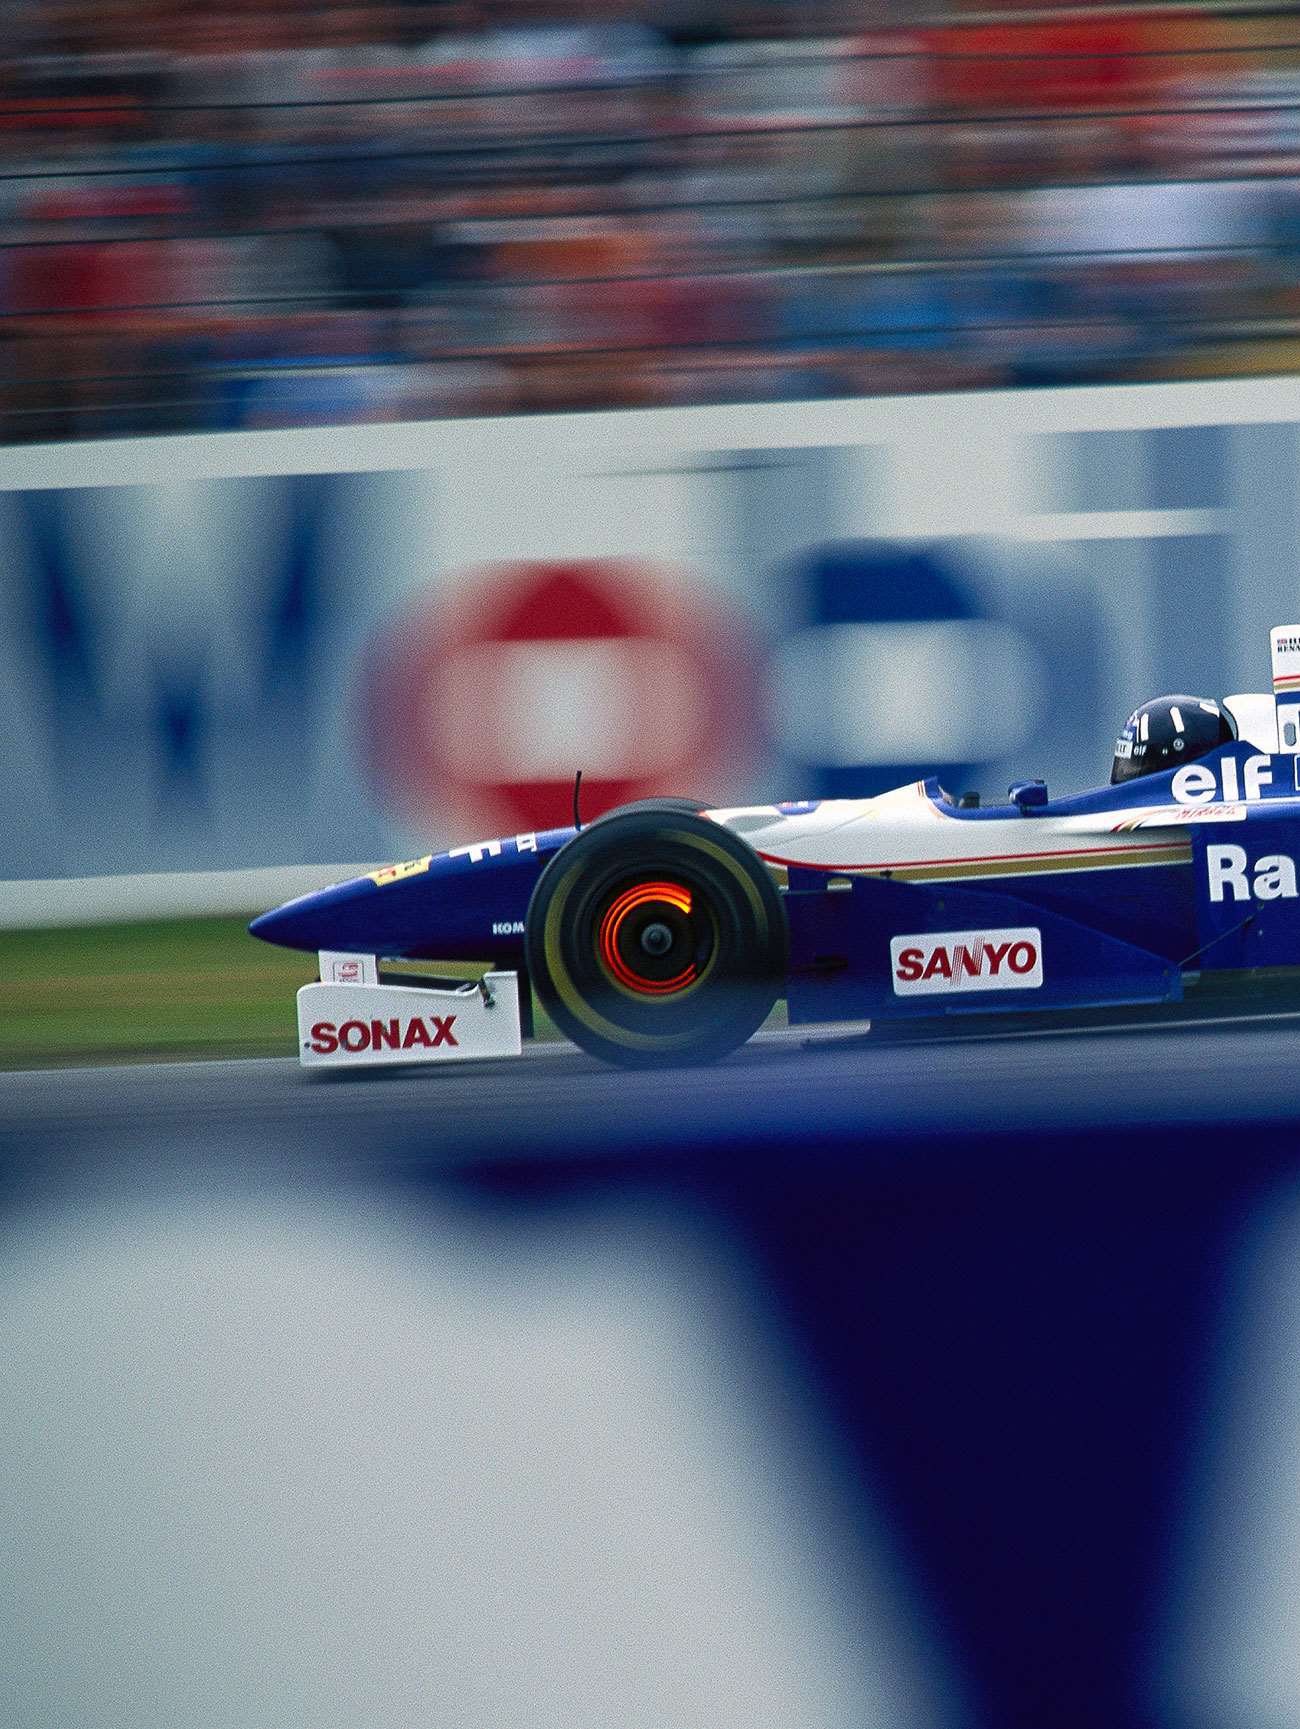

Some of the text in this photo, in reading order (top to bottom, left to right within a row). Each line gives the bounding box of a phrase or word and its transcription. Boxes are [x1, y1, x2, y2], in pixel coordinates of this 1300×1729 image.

[1171, 755, 1273, 803] elf
[493, 921, 525, 935] KOM
[896, 936, 1037, 986] SANYO
[310, 1015, 459, 1054] SONAX
